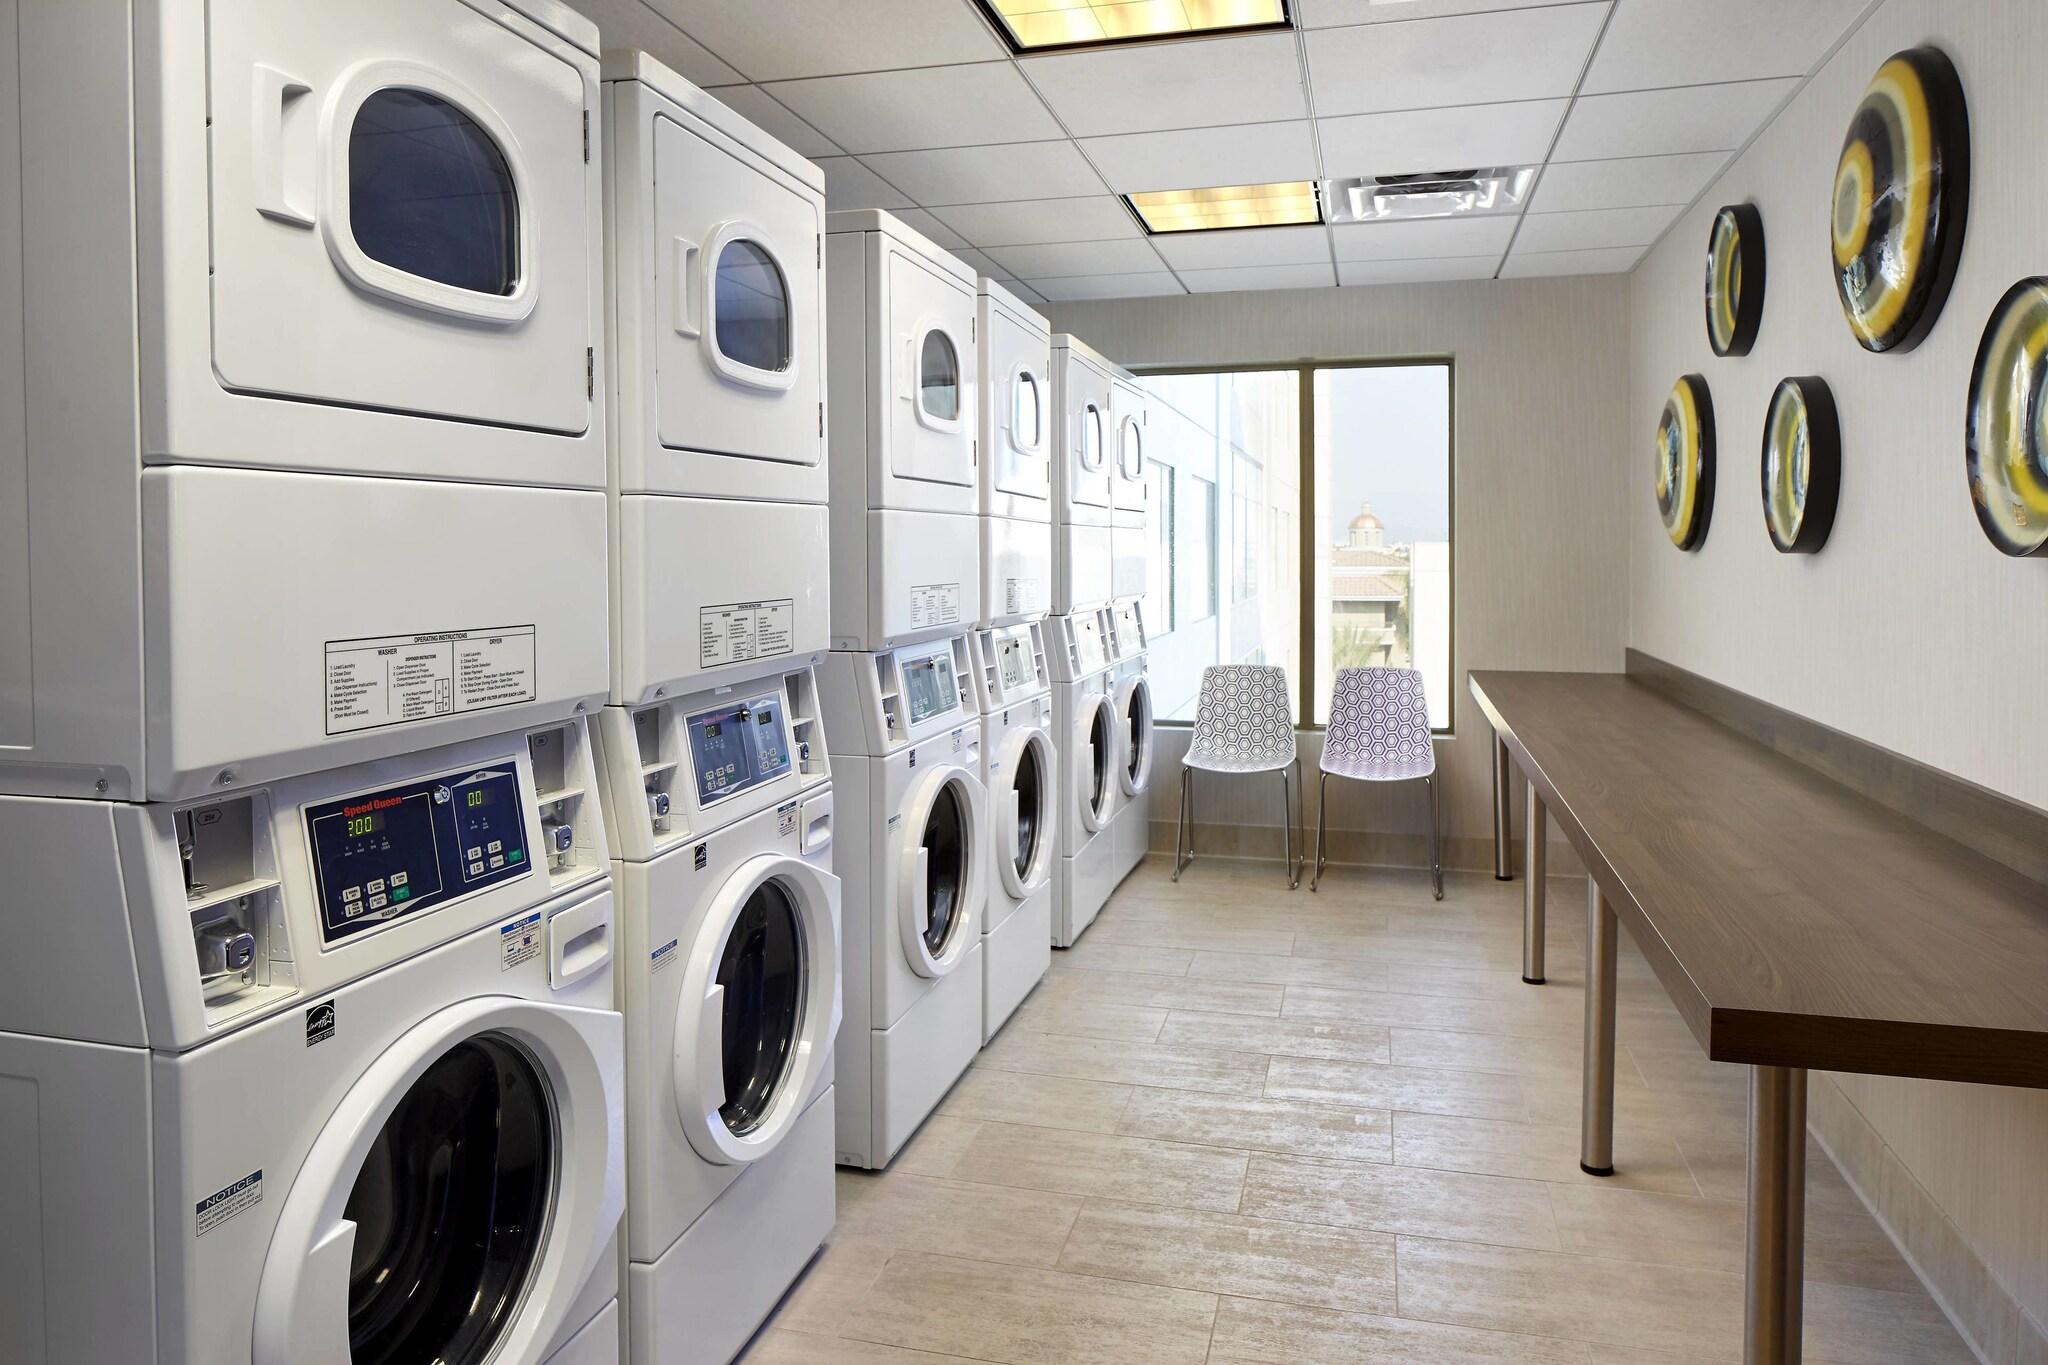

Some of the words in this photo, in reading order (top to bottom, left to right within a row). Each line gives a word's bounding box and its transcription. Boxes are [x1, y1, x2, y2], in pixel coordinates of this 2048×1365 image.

[414, 635, 438, 643] OPERATING
[439, 632, 468, 640] INSTRUCTIONS
[468, 790, 482, 806] 00
[344, 801, 373, 818] Speed
[374, 797, 402, 810] Queen
[381, 907, 397, 917] WASHER
[307, 1034, 323, 1046] ENERGY
[323, 1030, 335, 1038] STAR
[206, 1175, 254, 1208] NOTICE
[199, 1208, 212, 1220] DOOR
[212, 1202, 225, 1212] LOCK
[225, 1195, 238, 1206] LIGHT
[212, 1205, 231, 1219] attempting
